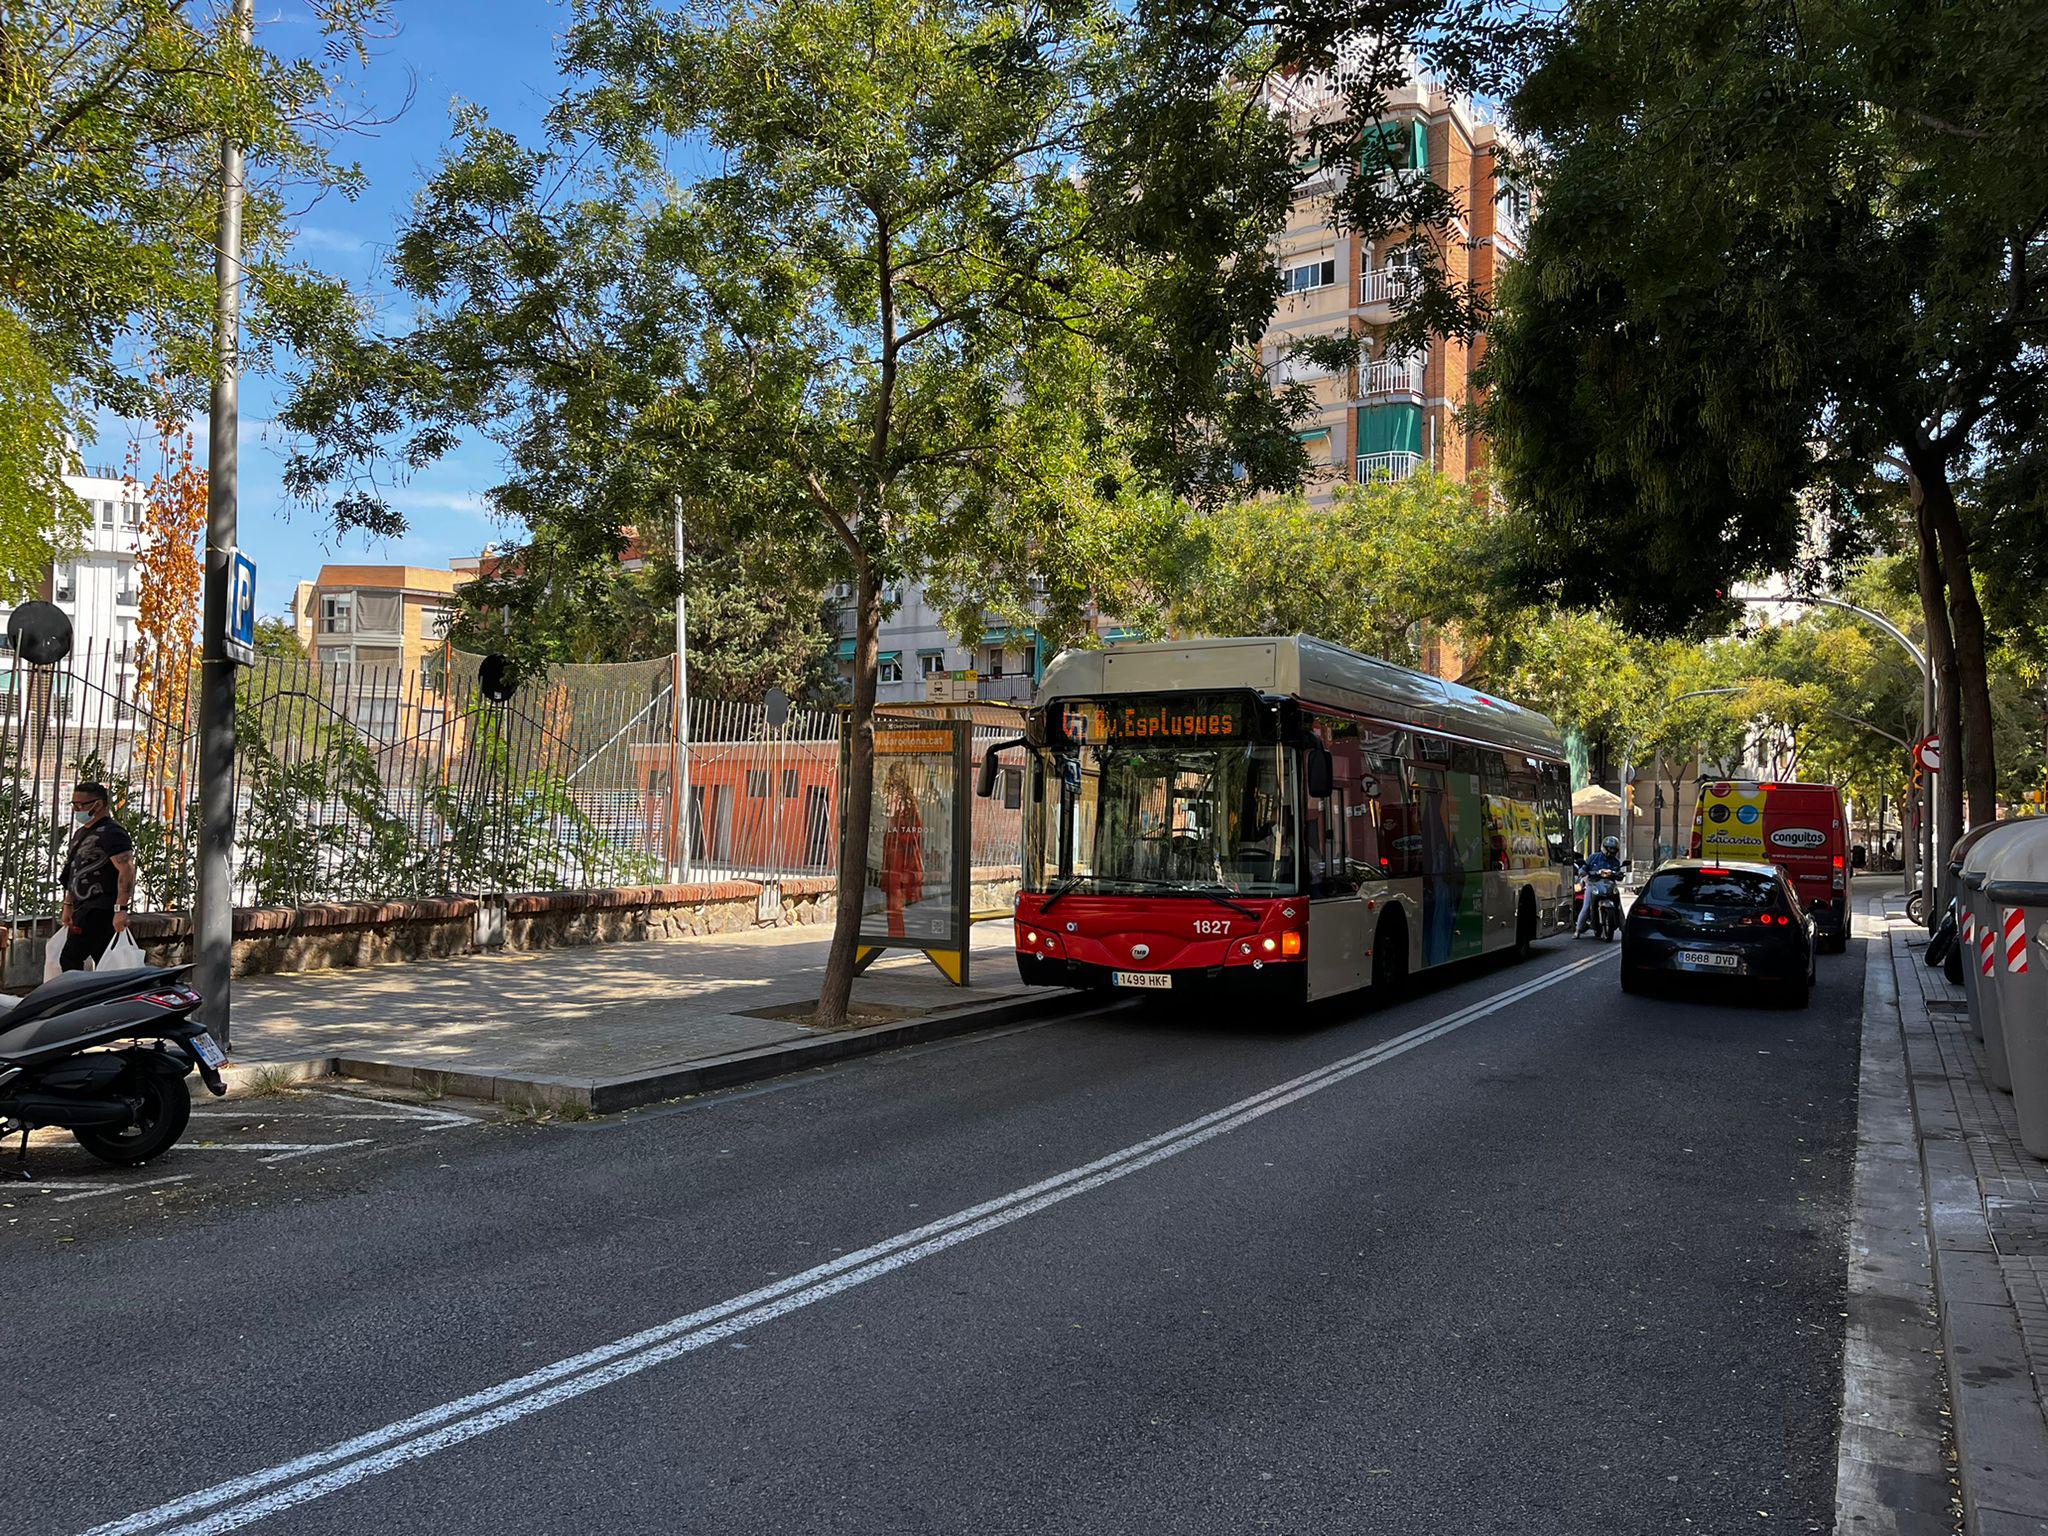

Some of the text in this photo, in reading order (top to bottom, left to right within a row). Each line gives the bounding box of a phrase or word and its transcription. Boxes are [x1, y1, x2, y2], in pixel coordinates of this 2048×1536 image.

[236, 563, 252, 631] P
[901, 826, 935, 834] TARDOR
[1706, 833, 1762, 845] Lacasitos
[1772, 830, 1824, 845] conguitos
[1193, 920, 1231, 934] 1827
[1715, 955, 1735, 966] DVD
[1121, 974, 1168, 987] 1499 HKF
